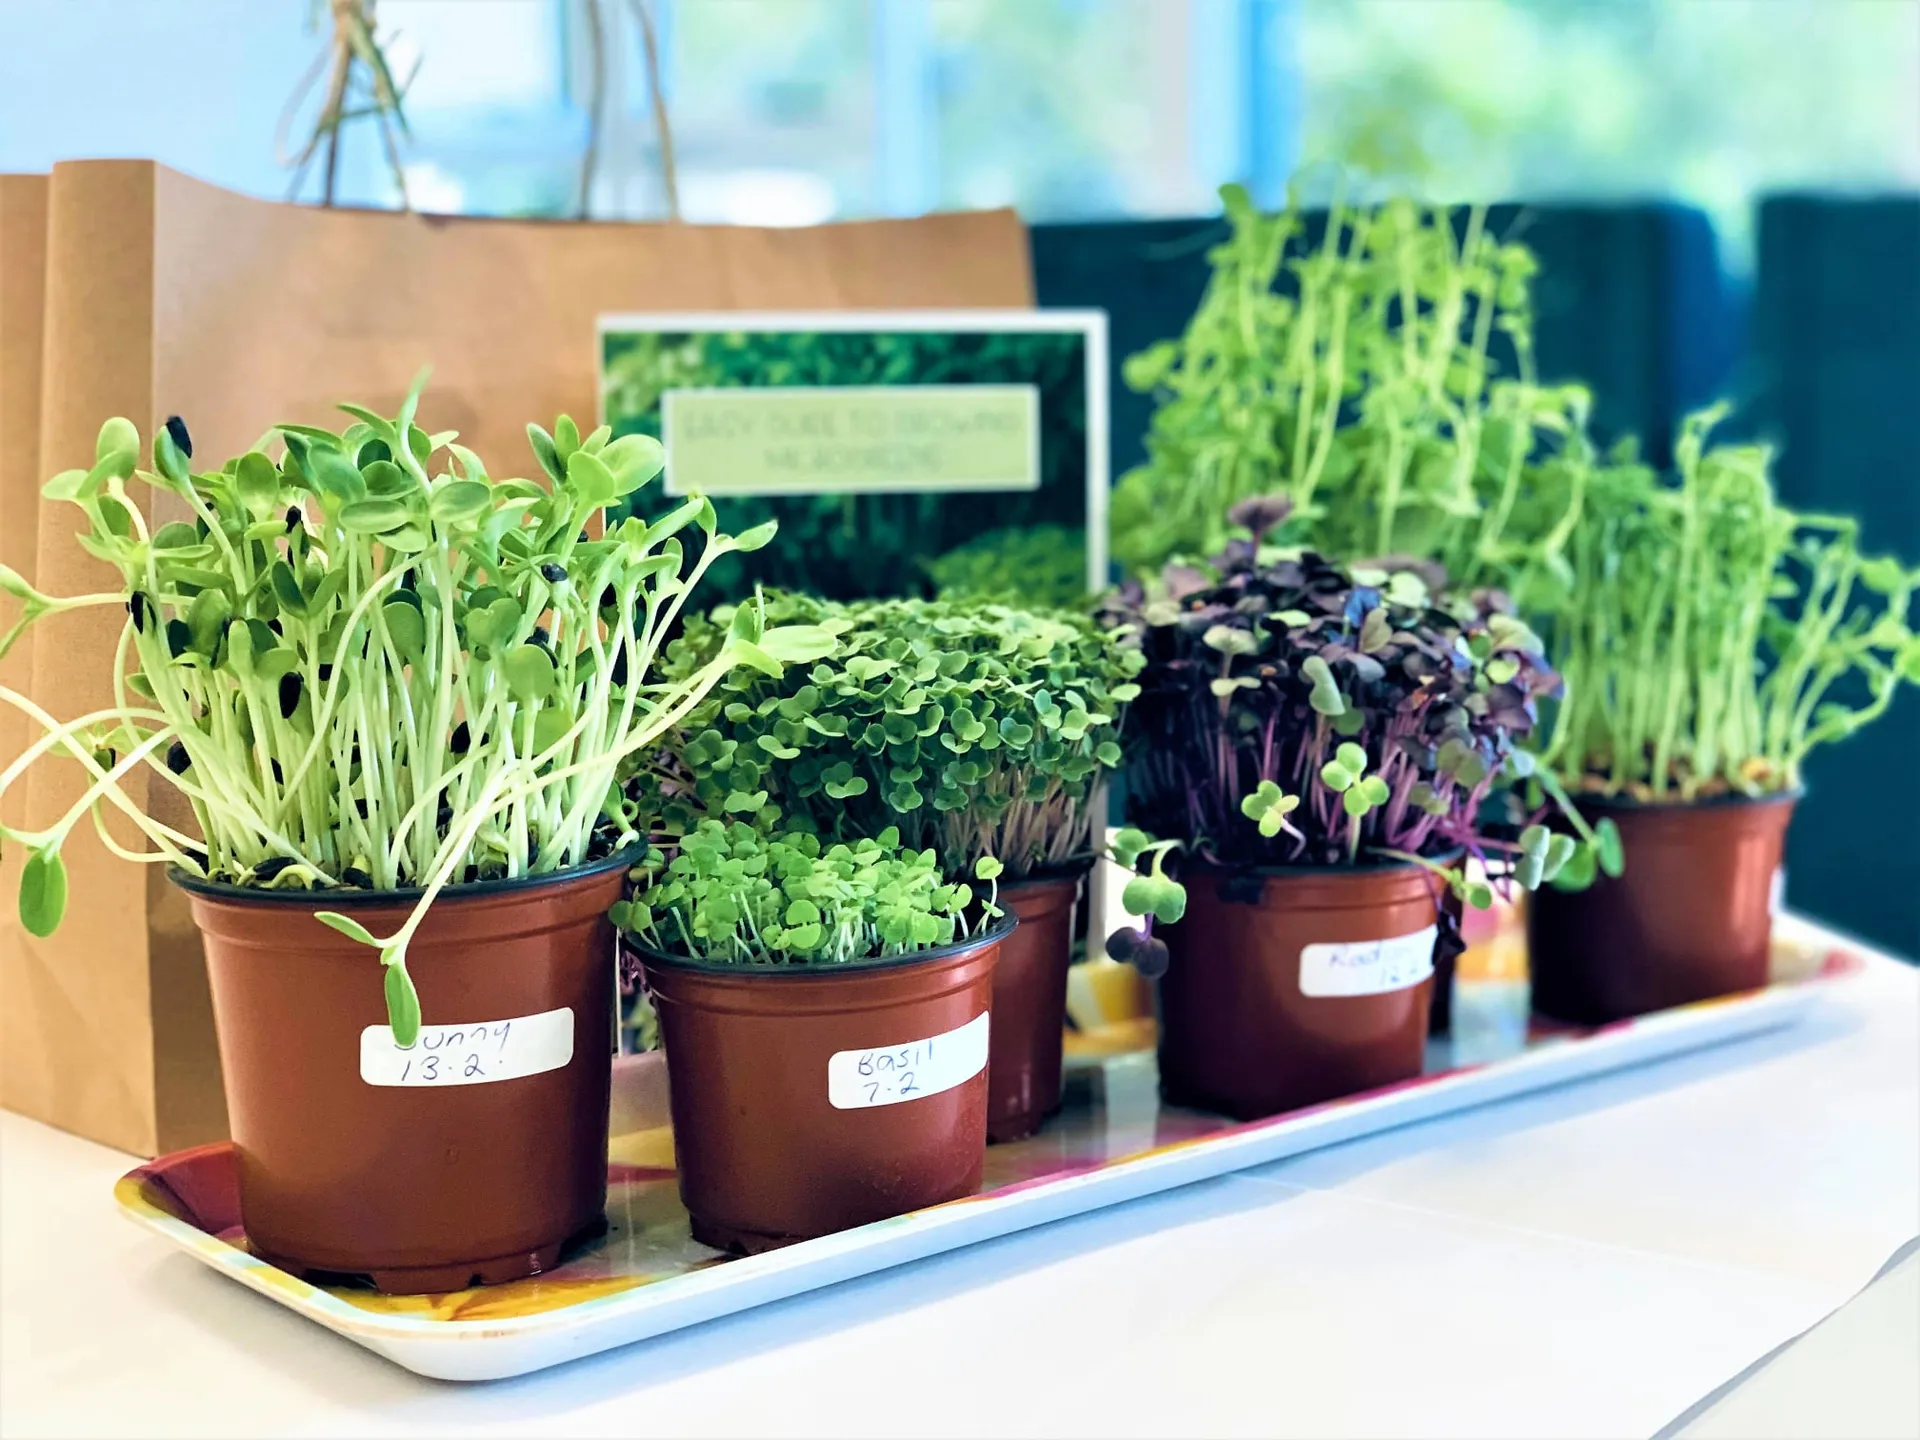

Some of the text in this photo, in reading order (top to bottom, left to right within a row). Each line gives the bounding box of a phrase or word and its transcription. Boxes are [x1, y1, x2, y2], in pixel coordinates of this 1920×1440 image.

[395, 1022, 511, 1053] unny
[858, 1040, 932, 1076] Basil
[862, 1071, 920, 1103] 7.2
